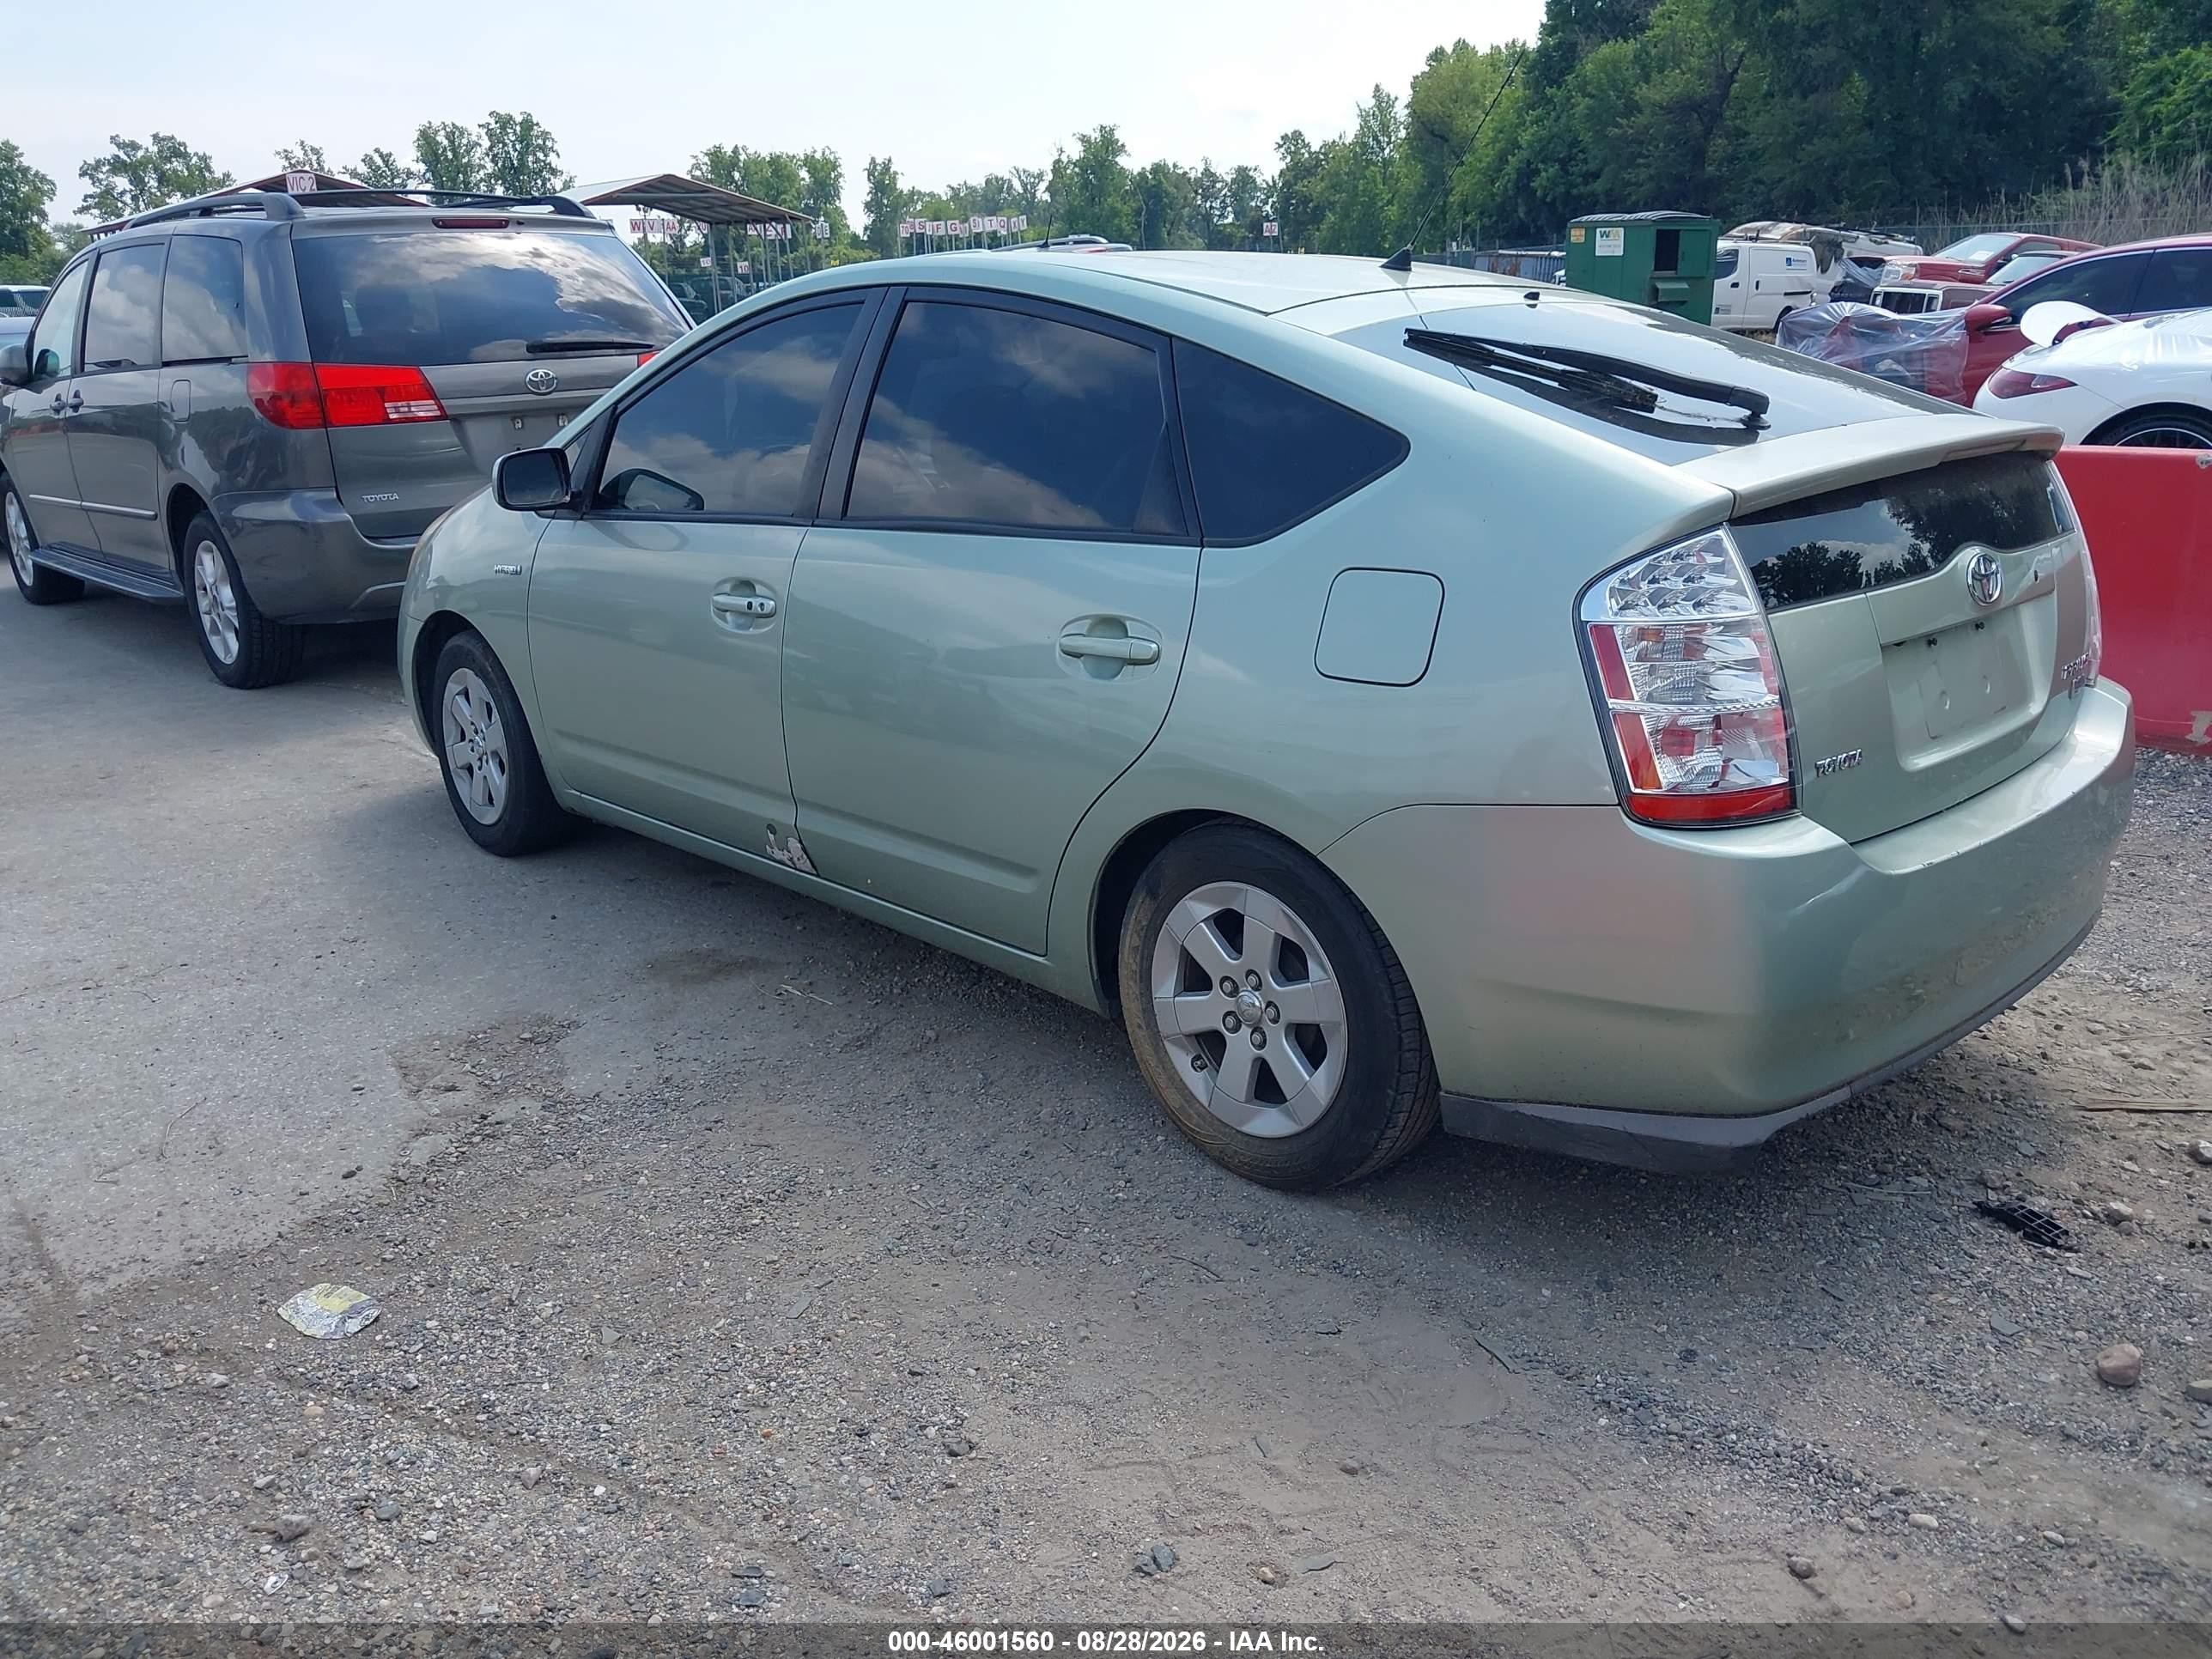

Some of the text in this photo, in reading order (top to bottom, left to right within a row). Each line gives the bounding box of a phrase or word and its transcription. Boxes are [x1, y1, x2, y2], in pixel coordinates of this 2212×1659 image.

[287, 175, 316, 191] VIC 2
[630, 221, 641, 231] W
[647, 220, 655, 231] V
[665, 221, 677, 231] AA
[918, 221, 925, 230] S
[950, 222, 957, 232] G
[988, 219, 994, 228] T
[936, 224, 942, 234] F
[362, 492, 399, 502] TOYOTA
